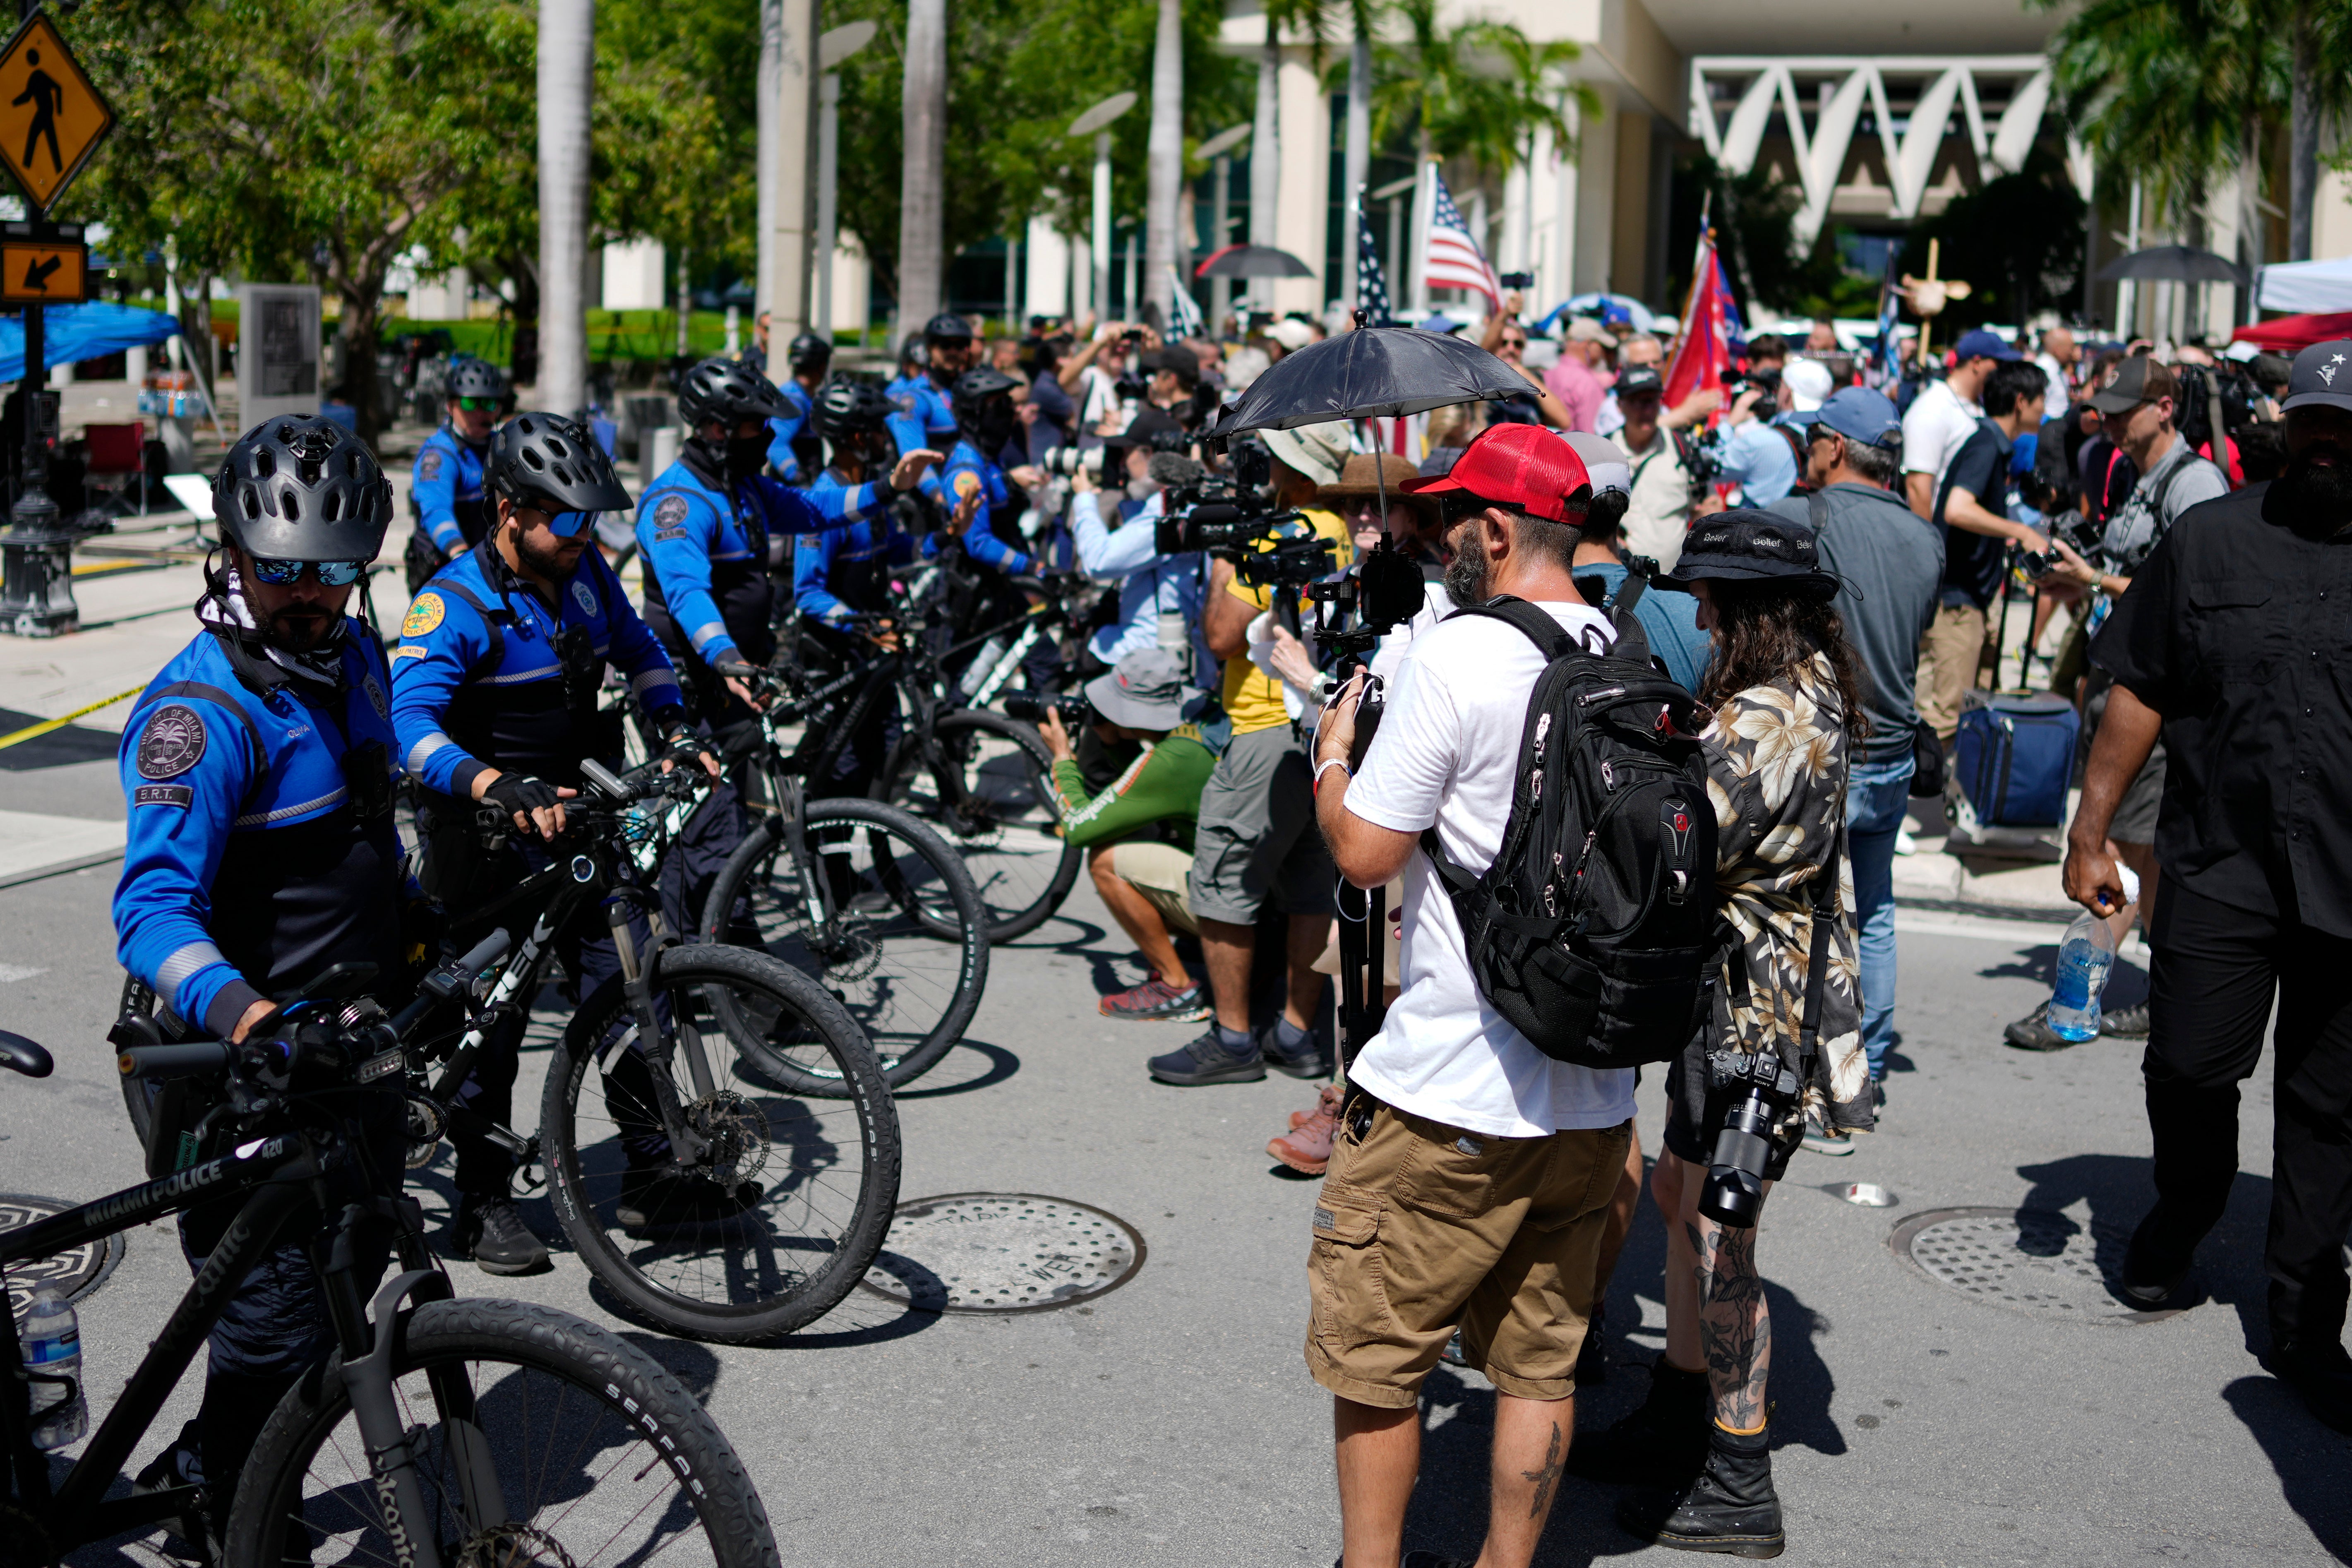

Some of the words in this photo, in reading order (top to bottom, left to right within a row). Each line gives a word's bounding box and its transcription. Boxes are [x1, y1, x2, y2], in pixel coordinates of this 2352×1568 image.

[432, 597, 442, 617] MIAMI
[404, 627, 425, 636] POLICE
[406, 648, 424, 656] PATROL
[150, 712, 166, 728] CITY
[171, 709, 183, 717] OF
[182, 713, 202, 743] MIAMI
[287, 724, 310, 738] OLIVA
[144, 761, 180, 774] POLICE
[140, 789, 173, 800] B.R.T.
[1753, 1078, 1771, 1088] SONY
[851, 1071, 878, 1158] SERFAS
[262, 1138, 283, 1159] 420
[83, 1185, 151, 1227] MIAMI
[151, 1158, 223, 1202] POLICE
[605, 1382, 705, 1496] SERFAS
